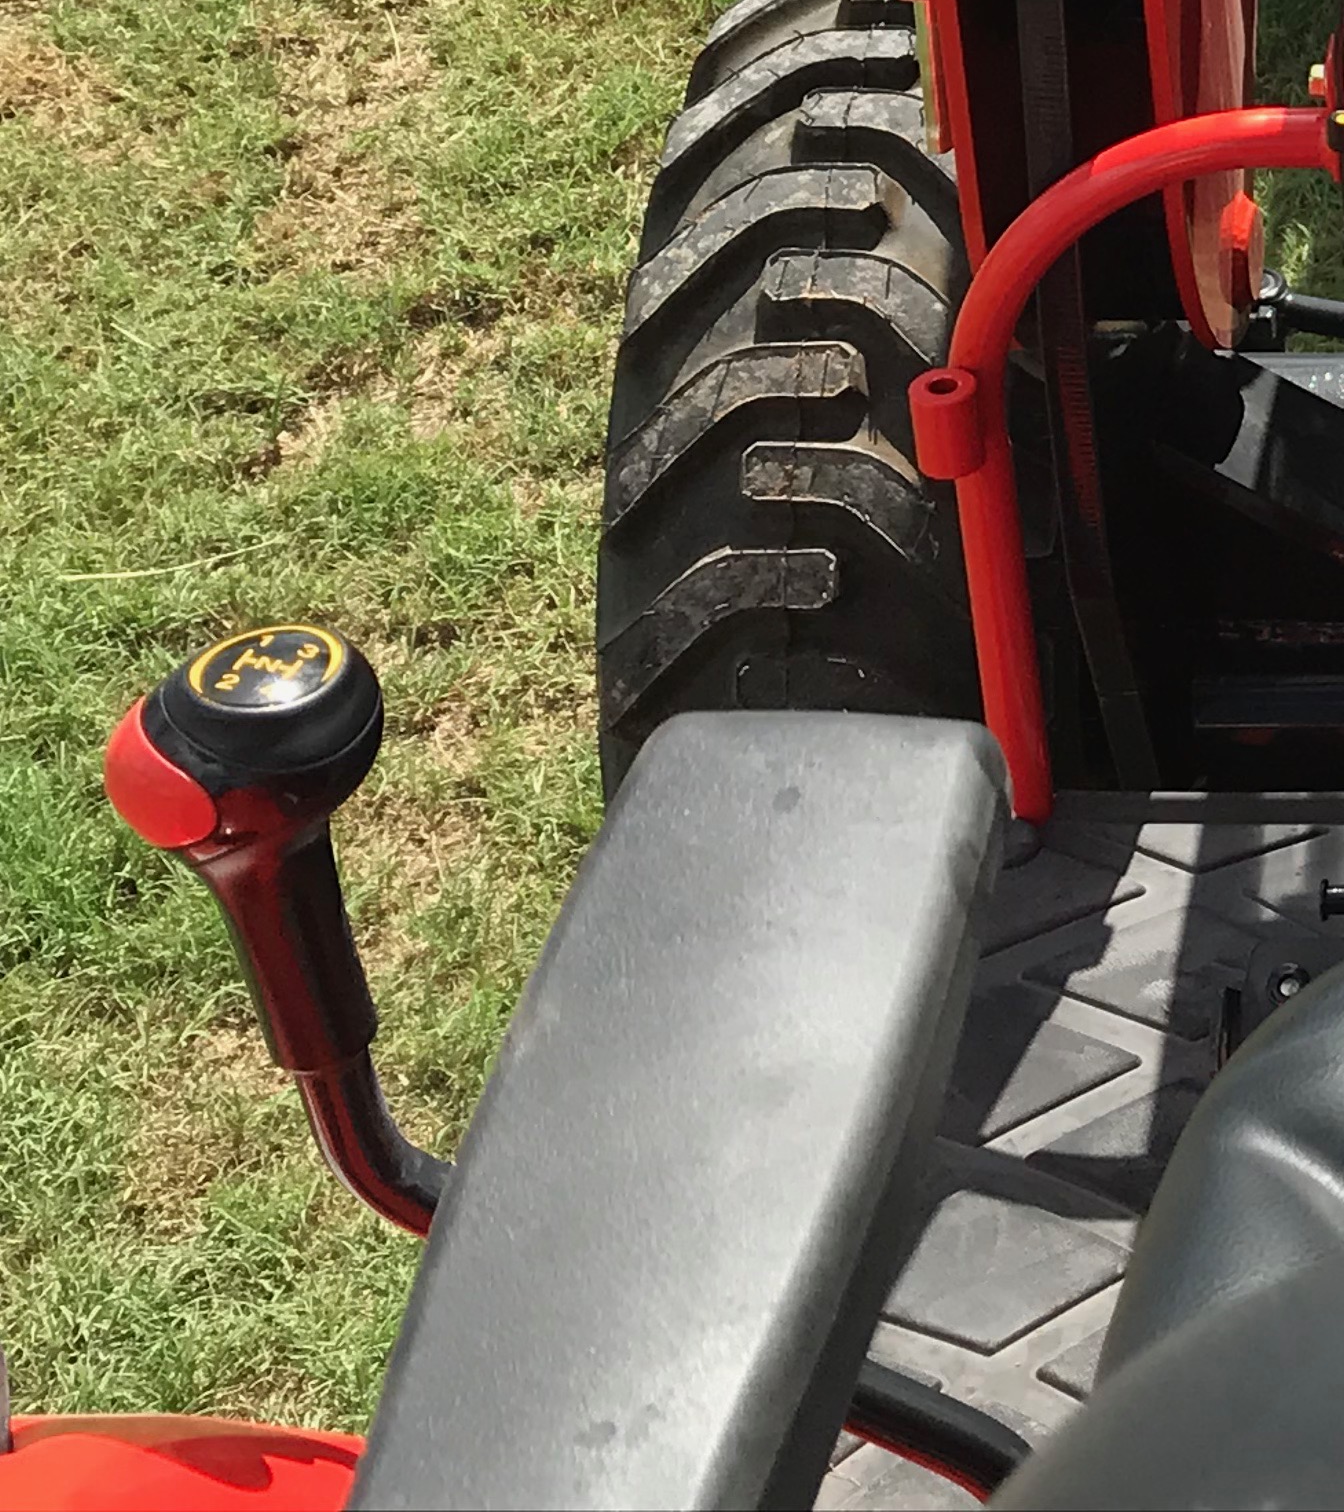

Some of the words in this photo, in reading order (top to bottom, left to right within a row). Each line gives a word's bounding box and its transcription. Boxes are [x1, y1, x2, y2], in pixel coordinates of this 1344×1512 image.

[258, 634, 275, 648] 1
[296, 643, 320, 659] 3
[254, 656, 283, 673] N
[214, 673, 240, 691] 2
